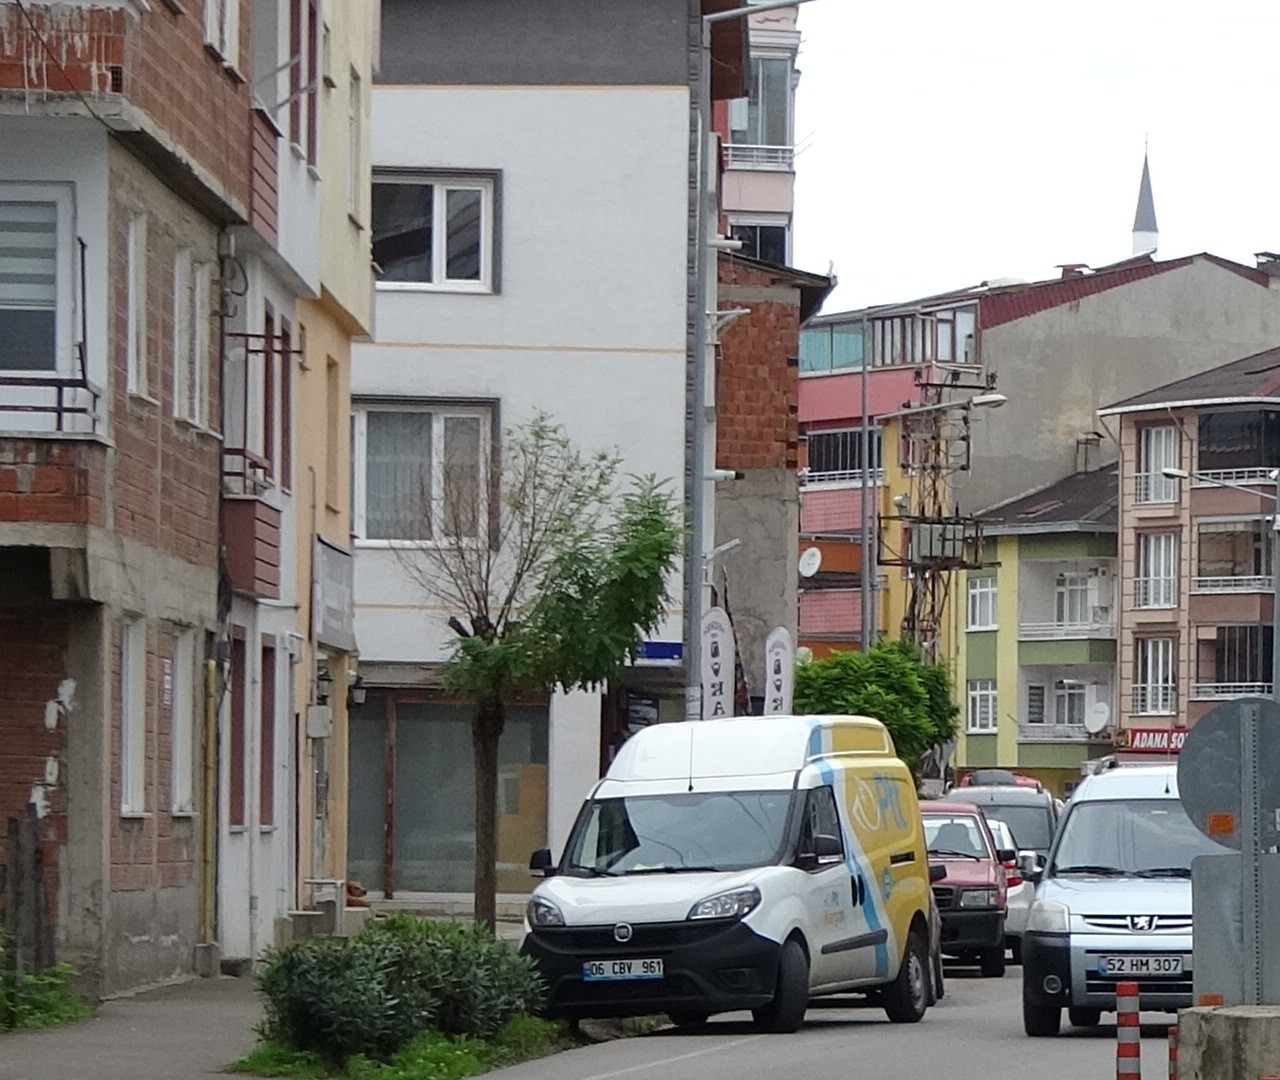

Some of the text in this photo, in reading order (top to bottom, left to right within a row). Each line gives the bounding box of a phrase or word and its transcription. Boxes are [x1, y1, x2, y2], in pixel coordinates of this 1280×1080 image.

[1132, 732, 1189, 749] ADANA SO
[590, 960, 662, 976] 06 CBV 961
[1107, 958, 1181, 972] 52 HM 307
